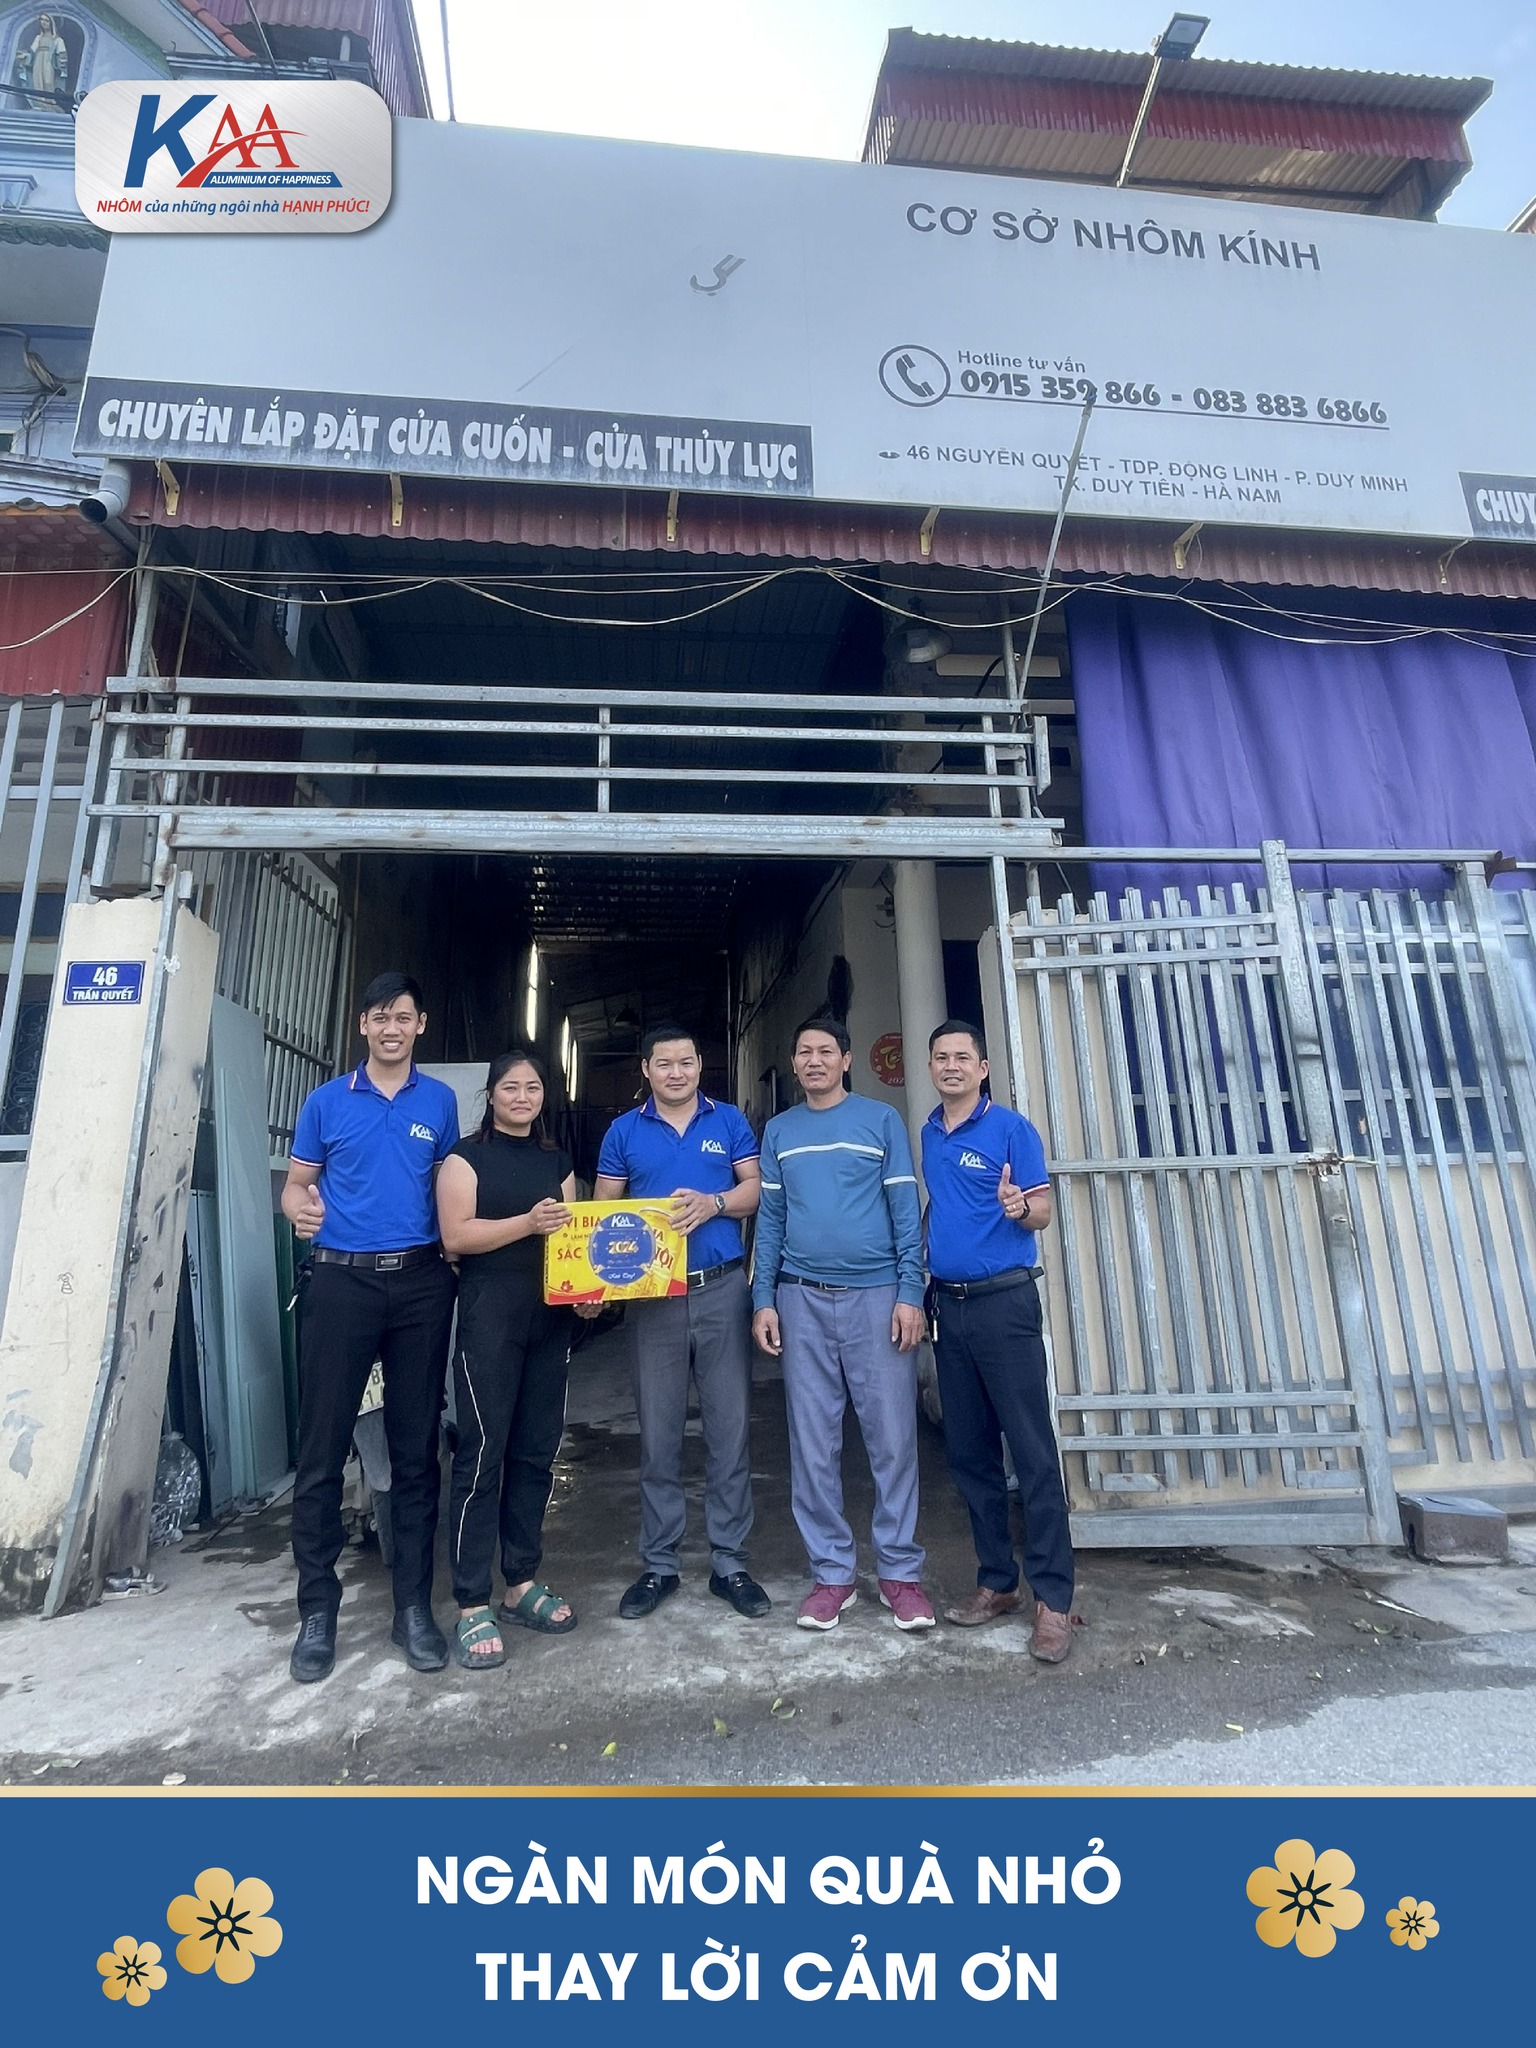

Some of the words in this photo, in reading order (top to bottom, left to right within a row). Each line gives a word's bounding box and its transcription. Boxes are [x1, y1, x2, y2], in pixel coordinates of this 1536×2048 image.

[906, 202, 978, 236] CƠ
[991, 208, 1059, 244] SỞ
[1073, 218, 1206, 259] NHÔM
[1218, 229, 1322, 272] KÍNH
[957, 350, 1023, 368] Hotline
[1028, 355, 1049, 370] tư
[1053, 355, 1086, 373] vấn
[960, 369, 1031, 397] 0915
[1041, 375, 1097, 403] 359
[1105, 380, 1162, 406] 866
[1193, 387, 1248, 413] 083
[1256, 392, 1309, 419] 883
[1317, 396, 1388, 425] 6866
[98, 397, 233, 444] CHUYÊN
[241, 395, 306, 448] LẮP
[313, 407, 380, 461] ĐẶT
[388, 408, 453, 457] CỬA
[462, 413, 552, 464] CUỐN
[563, 445, 575, 458] -
[586, 422, 648, 471] CỬA
[655, 428, 735, 476] THỦY
[743, 442, 798, 489] LỰC
[906, 444, 930, 460] 46
[936, 446, 1025, 467] NGUYỄN
[1119, 458, 1163, 476] TDP.
[1168, 461, 1228, 482] ĐỘNG
[1233, 466, 1279, 484] LINH
[1295, 471, 1311, 487] P.
[1317, 473, 1355, 489] DUY
[1360, 474, 1409, 493] MINH
[1092, 477, 1134, 495] DUY
[1138, 478, 1186, 498] TIÊN
[1204, 481, 1232, 500] HÀ
[1237, 487, 1282, 503] NAM
[92, 966, 118, 986] 46
[101, 987, 134, 1001] QUYẾT
[410, 1123, 434, 1141] KAA
[608, 1241, 639, 1255] 2024
